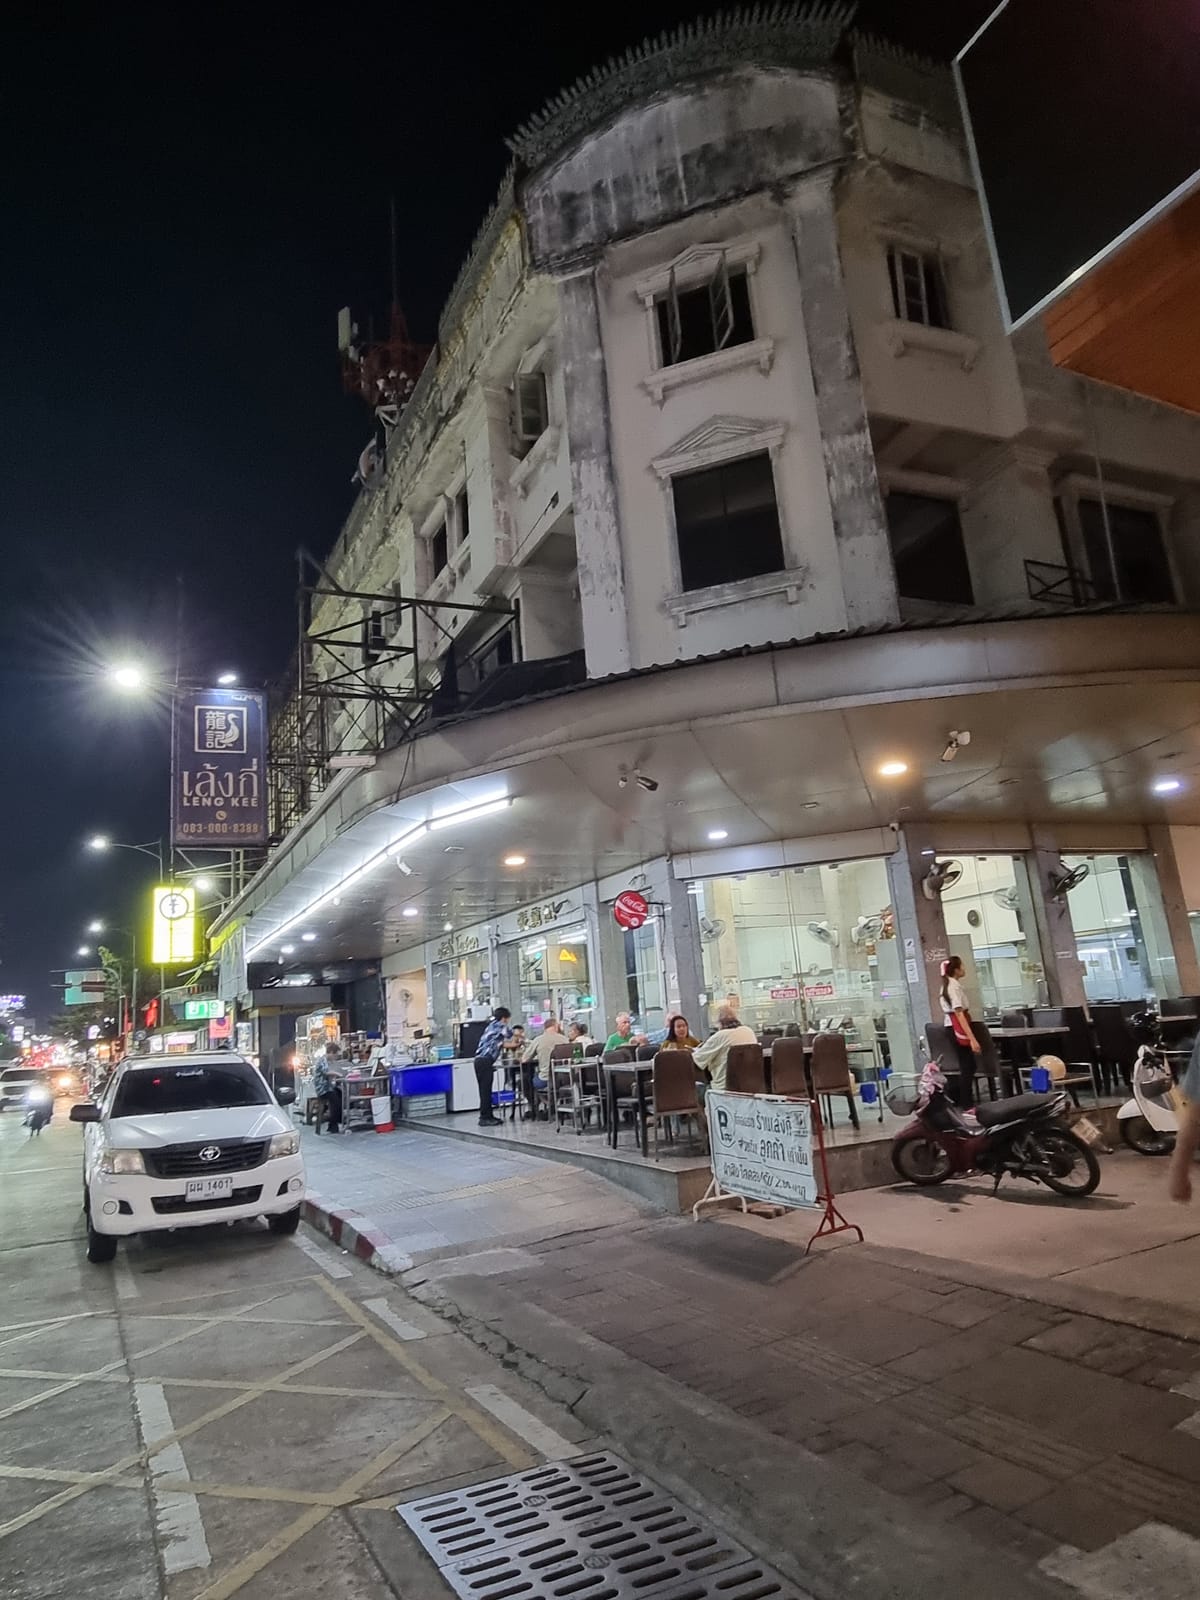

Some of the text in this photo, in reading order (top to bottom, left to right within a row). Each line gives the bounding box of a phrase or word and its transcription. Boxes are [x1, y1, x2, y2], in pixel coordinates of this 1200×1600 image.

[183, 758, 258, 798] เล้งกี่
[183, 797, 259, 807] LENG KEE
[760, 1137, 785, 1162] ลูกค้า
[207, 1180, 229, 1191] 1401
